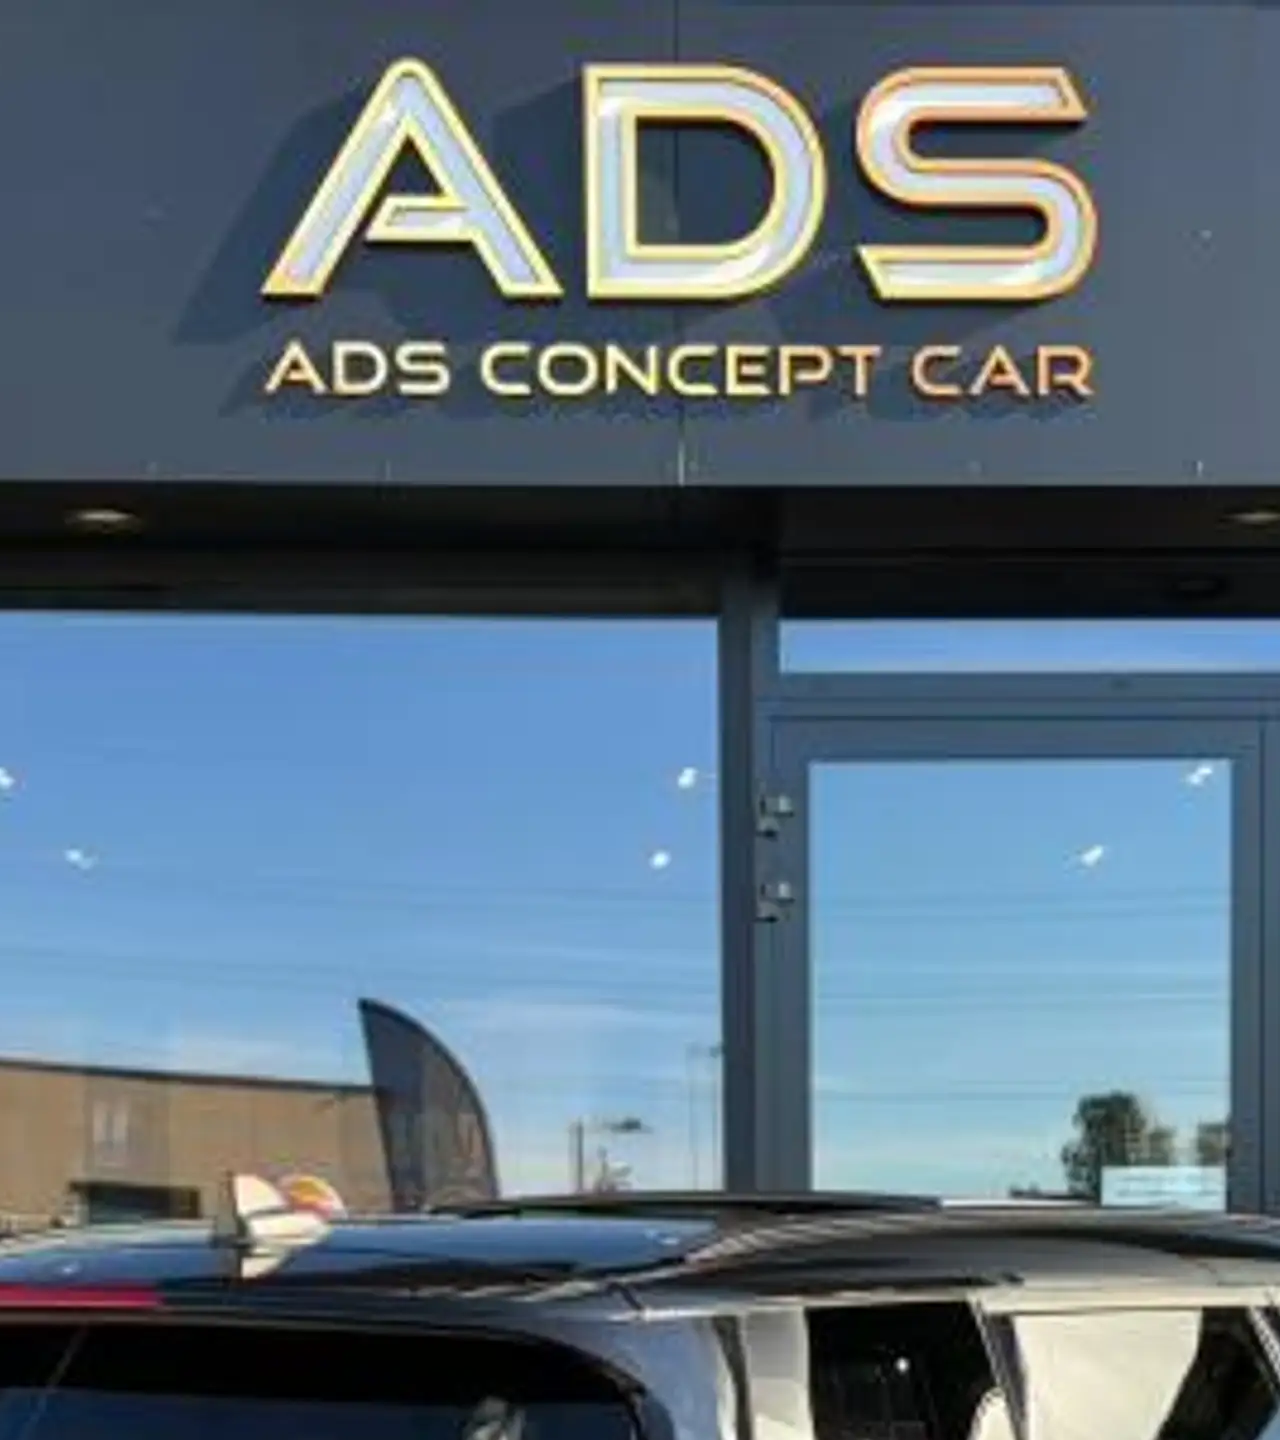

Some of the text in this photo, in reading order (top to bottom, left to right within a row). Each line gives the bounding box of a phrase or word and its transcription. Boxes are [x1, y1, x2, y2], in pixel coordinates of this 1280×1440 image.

[261, 56, 1097, 299] ADS
[264, 338, 1095, 396] ADS CONCEPT CAR
